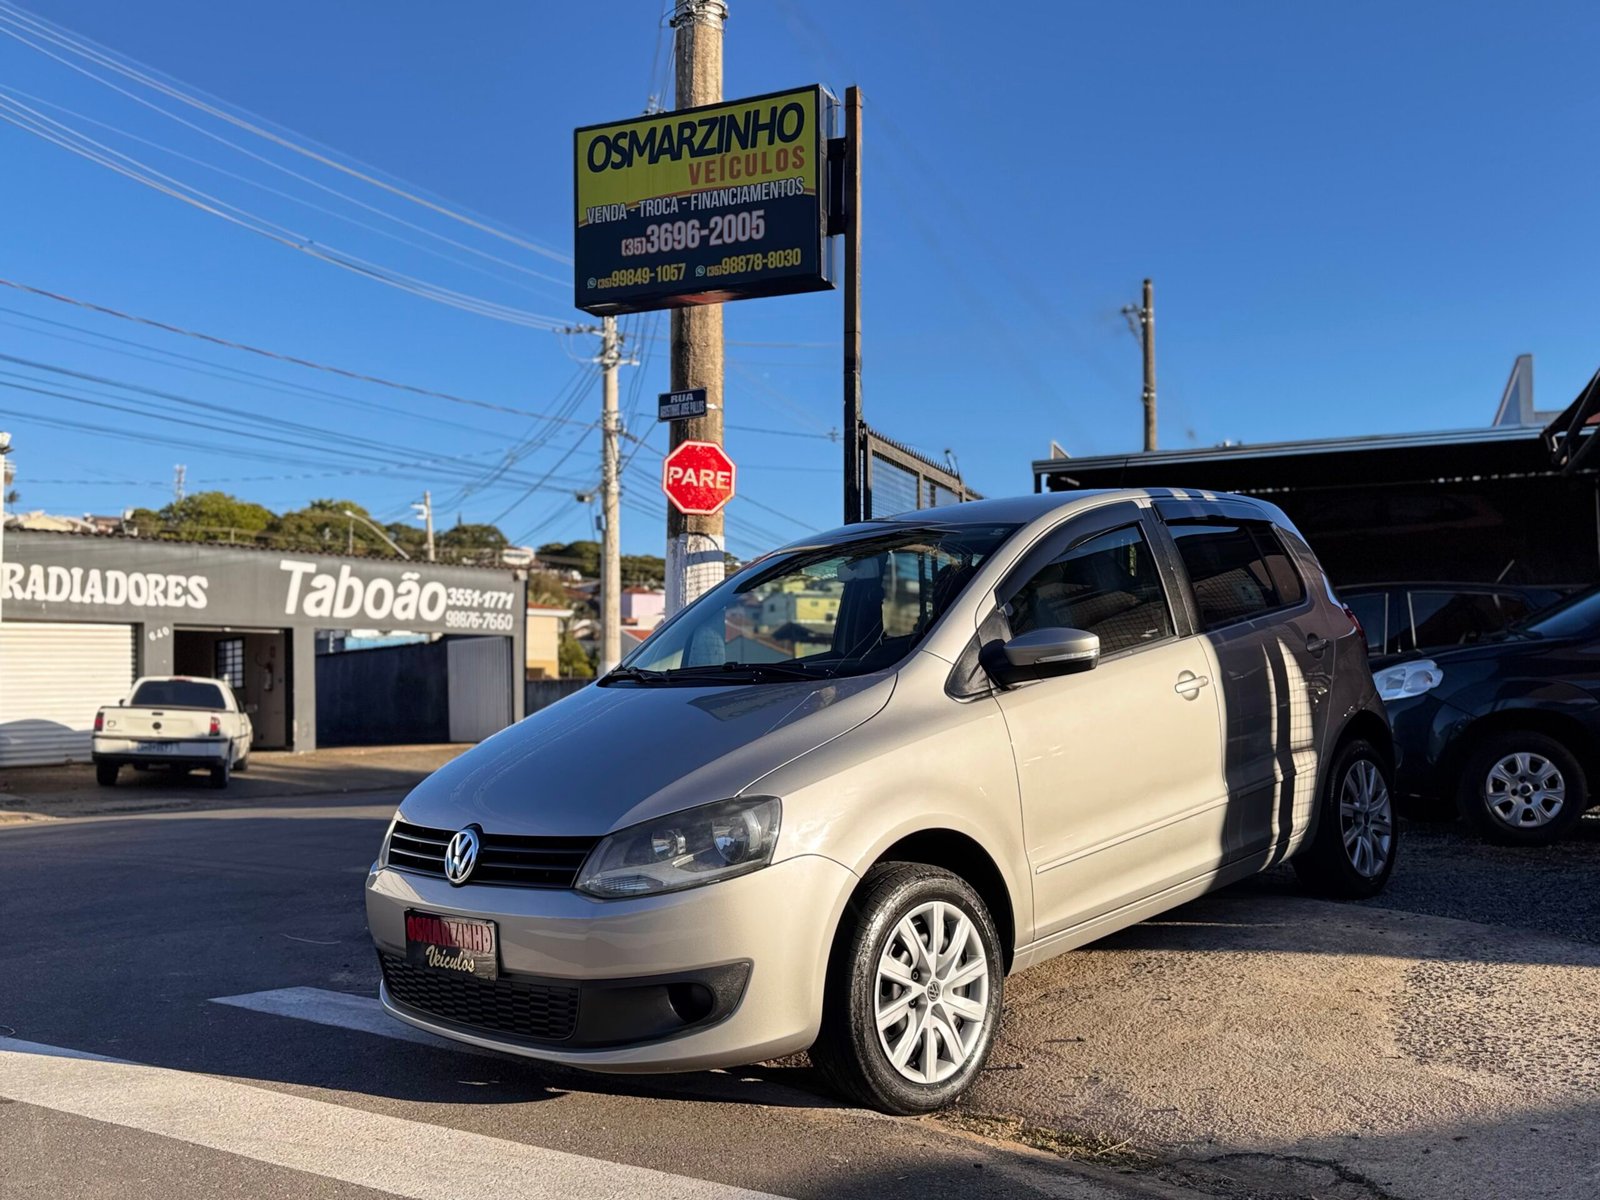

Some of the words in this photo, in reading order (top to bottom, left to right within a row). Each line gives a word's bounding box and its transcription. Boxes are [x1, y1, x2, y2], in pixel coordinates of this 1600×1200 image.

[587, 102, 805, 173] OSMARZINHO
[688, 145, 805, 185] VEÍCULOS
[586, 204, 628, 224] VENDA
[639, 197, 679, 219] TROCA
[690, 176, 805, 211] FINANCIAMENTOS
[670, 393, 694, 404] RUA
[668, 466, 731, 490] PARE
[1, 562, 209, 609] RADIADORES
[279, 559, 448, 622] Taboão
[447, 587, 515, 610] 3551-1771
[407, 916, 493, 953] OSMARZINHO
